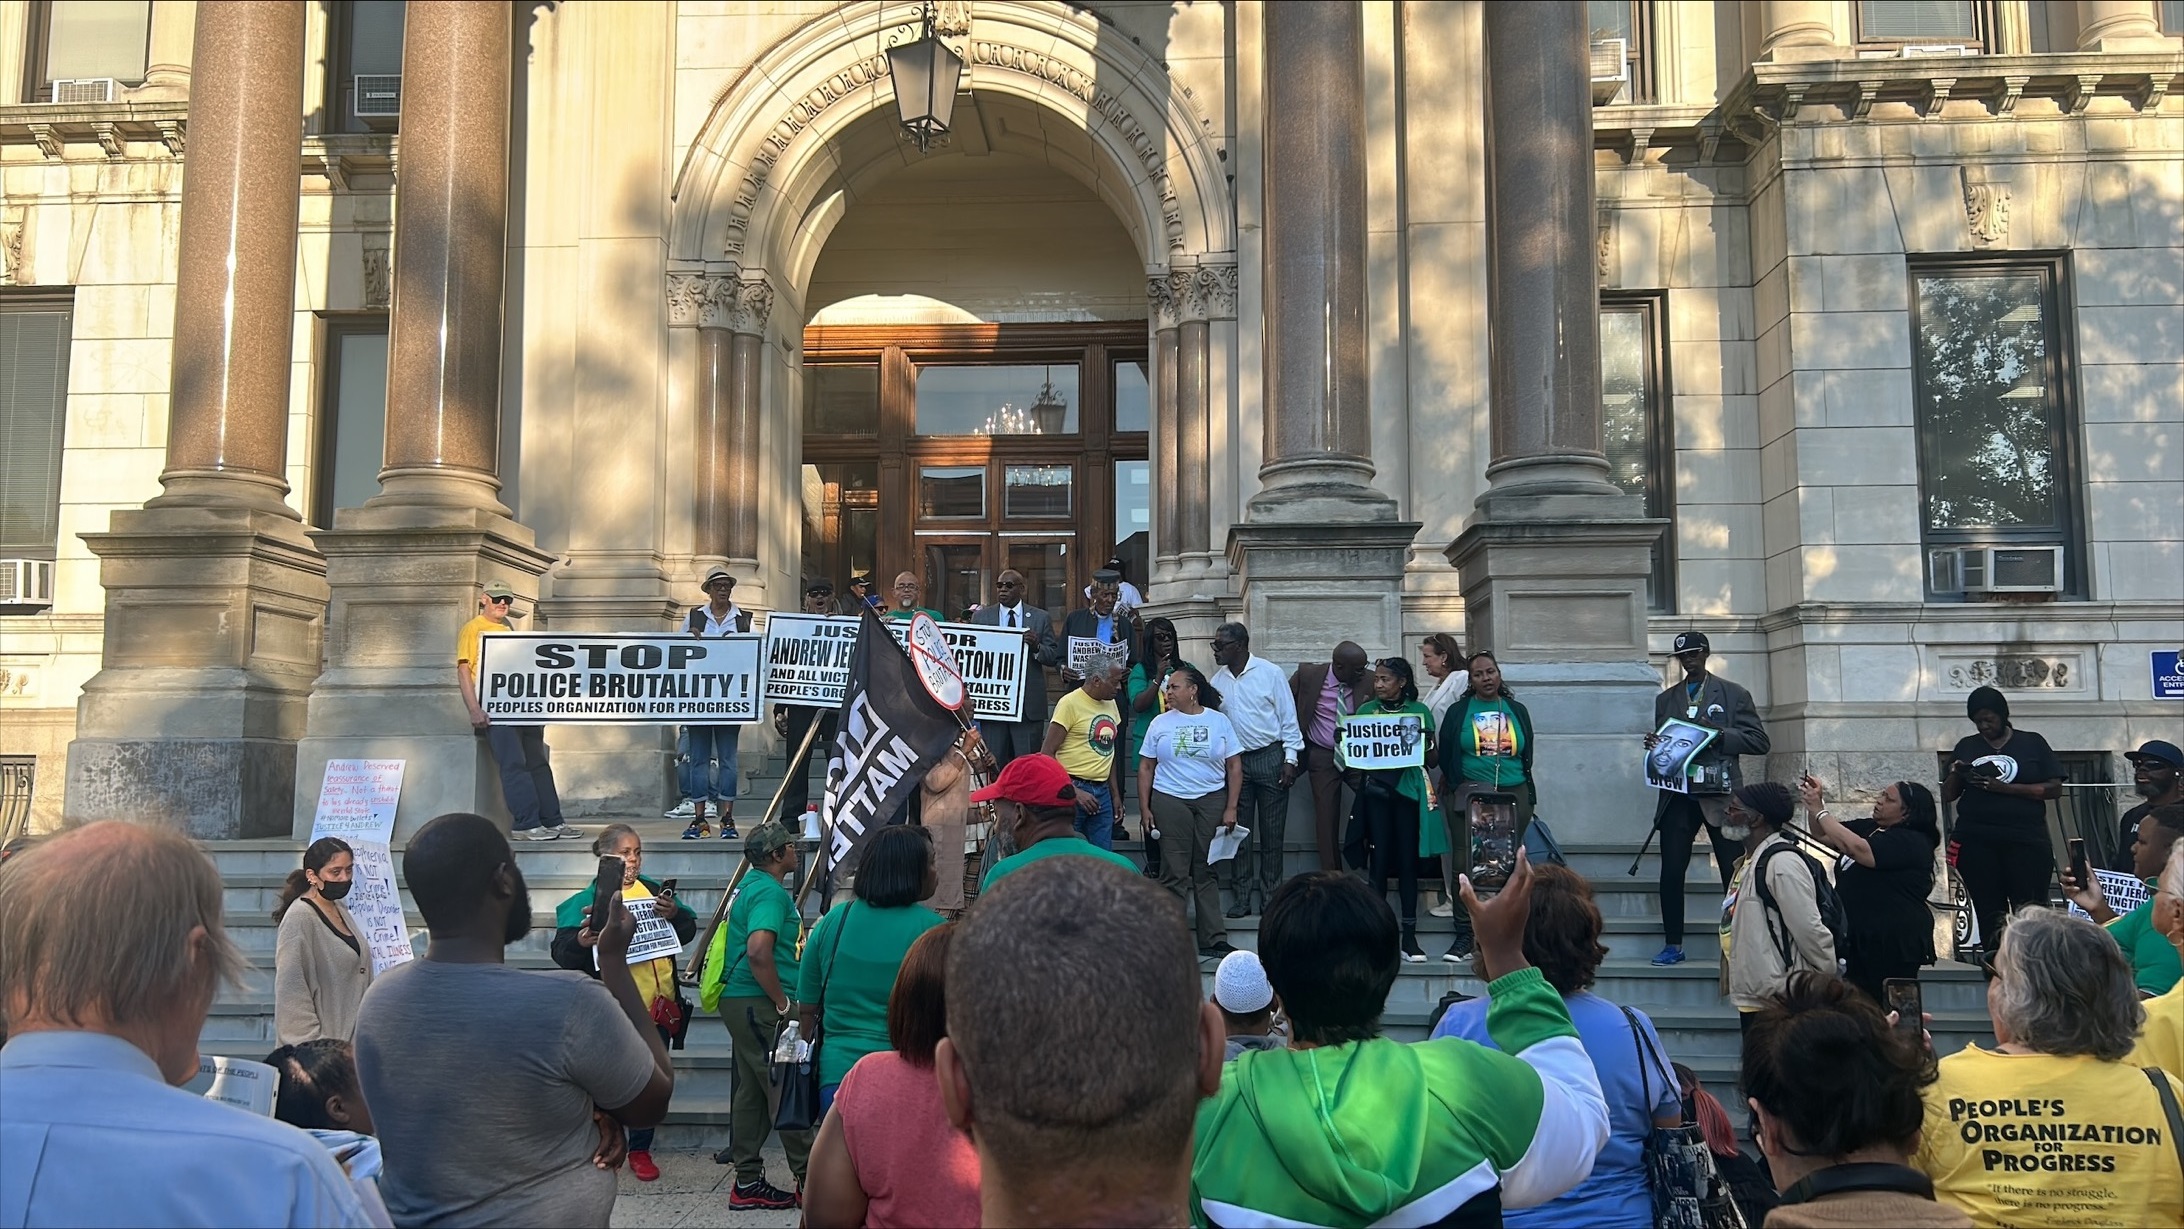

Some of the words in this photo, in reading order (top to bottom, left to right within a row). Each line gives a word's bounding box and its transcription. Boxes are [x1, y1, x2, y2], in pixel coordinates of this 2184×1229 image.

[944, 633, 977, 647] OR
[535, 644, 707, 669] STOP
[1073, 646, 1100, 655] ANDREW
[770, 638, 833, 667] ANDREW
[951, 649, 994, 679] GTON
[997, 653, 1015, 681] III
[490, 673, 581, 698] POLICE
[589, 674, 734, 697] BRUTALITY
[740, 674, 748, 697] !
[770, 668, 795, 679] AND
[797, 670, 817, 681] ALL
[820, 671, 849, 683] VICT
[964, 682, 1011, 695] TALITY
[767, 684, 819, 696] PEOPLE'S
[487, 702, 543, 713] PEOPLES
[547, 702, 645, 713] ORGANIZATION
[650, 702, 674, 713] FOR
[679, 702, 750, 713] PROGRESS
[1346, 722, 1400, 738] Justice
[1347, 742, 1369, 757] for
[1373, 742, 1413, 757] Drew
[328, 761, 358, 772] Andrew
[364, 760, 400, 770] Deserved
[351, 821, 383, 829] ANDREW
[364, 864, 377, 877] NOT
[2098, 876, 2136, 887] STICE
[2102, 884, 2124, 896] REW
[2125, 888, 2148, 900] JERO
[658, 919, 668, 929] III
[1949, 1098, 2065, 1121] PEOPLE'S
[1961, 1120, 2161, 1145] ORGANIZATION
[2034, 1142, 2063, 1153] FOR
[1982, 1150, 2115, 1173] PROGRESS
[2004, 1185, 2033, 1195] there
[2037, 1187, 2046, 1196] is
[2050, 1189, 2064, 1198] no
